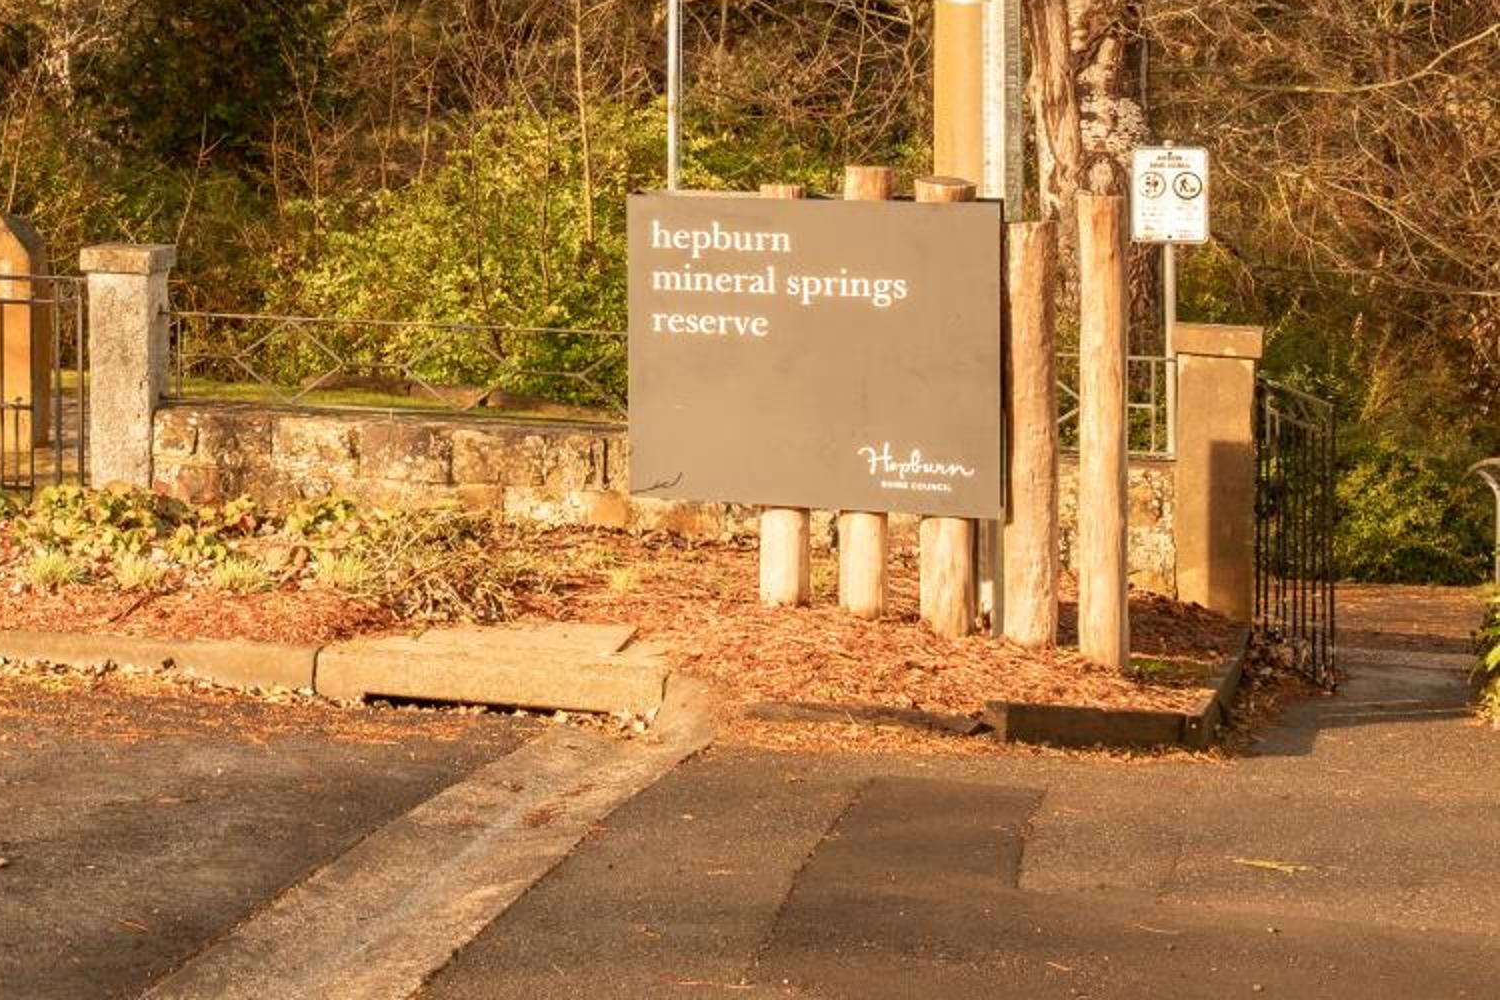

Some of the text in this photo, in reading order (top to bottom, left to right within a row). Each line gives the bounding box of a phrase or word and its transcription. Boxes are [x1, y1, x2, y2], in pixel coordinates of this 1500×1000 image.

[651, 220, 792, 258] hepburn
[651, 264, 908, 307] mineral springs
[651, 311, 770, 337] reserve
[857, 441, 975, 480] Hepburn
